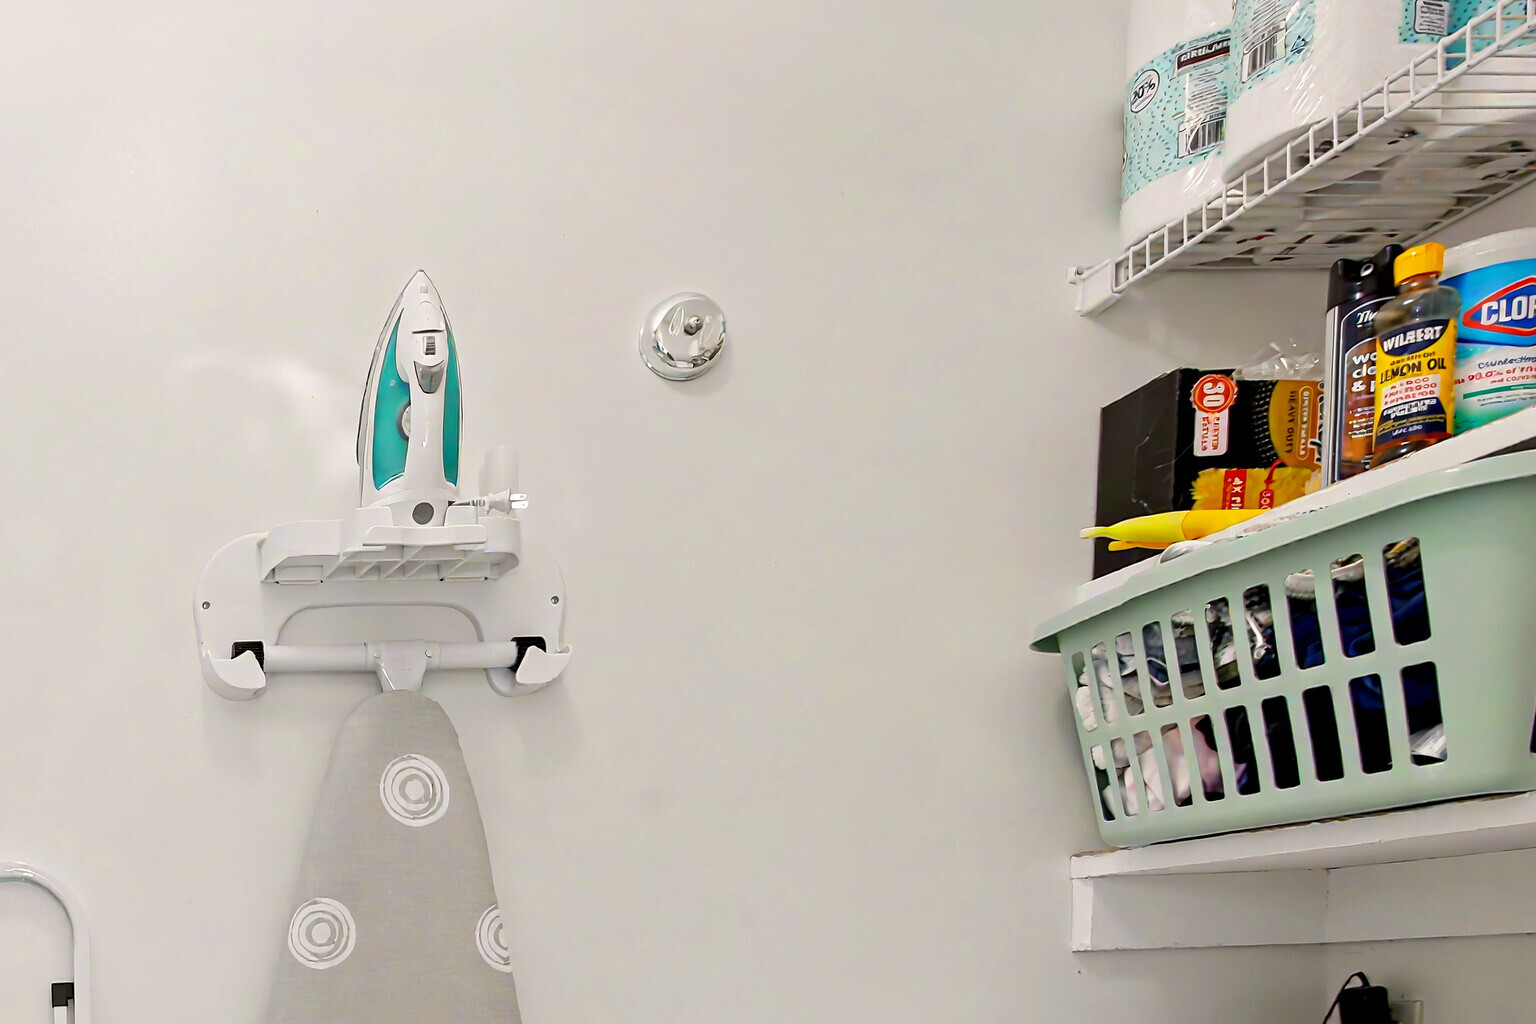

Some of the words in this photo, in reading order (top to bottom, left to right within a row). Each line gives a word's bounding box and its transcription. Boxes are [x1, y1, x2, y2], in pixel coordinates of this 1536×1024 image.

[1379, 360, 1422, 384] LEMON
[1427, 357, 1447, 371] OIL
[1202, 382, 1226, 408] 30
